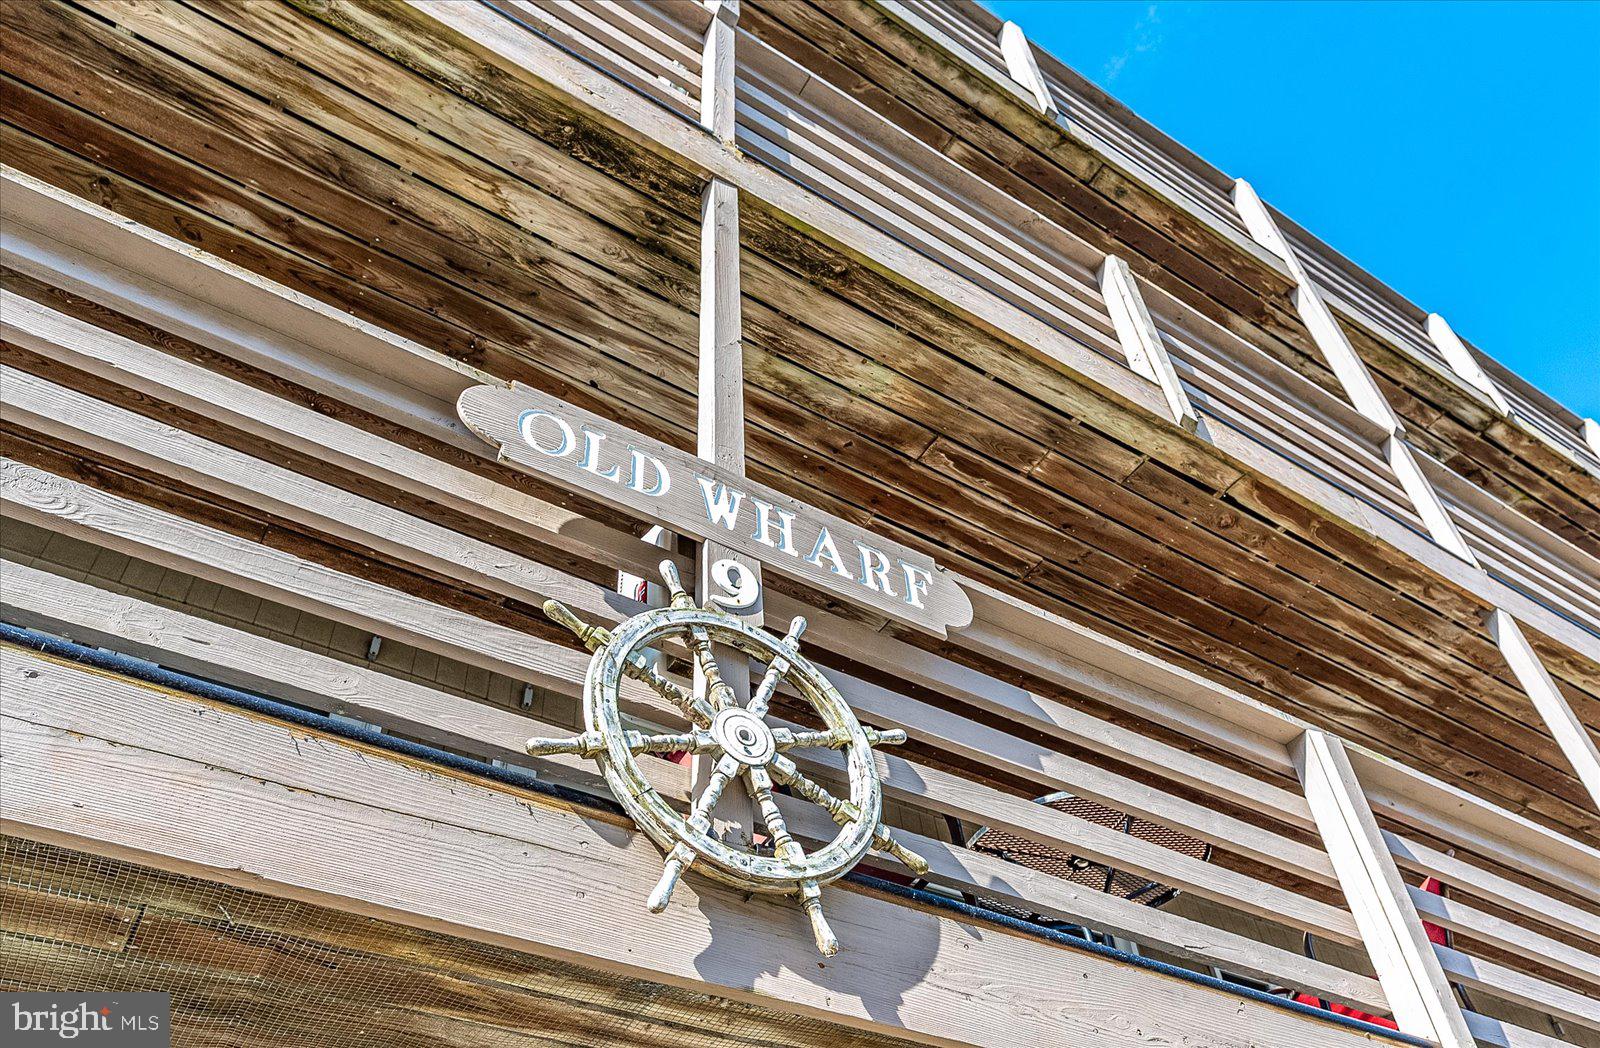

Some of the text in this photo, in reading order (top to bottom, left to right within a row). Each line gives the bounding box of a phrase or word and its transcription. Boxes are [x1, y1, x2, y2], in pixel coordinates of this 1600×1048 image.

[518, 410, 933, 609] OLD WHARF
[710, 558, 759, 608] 9
